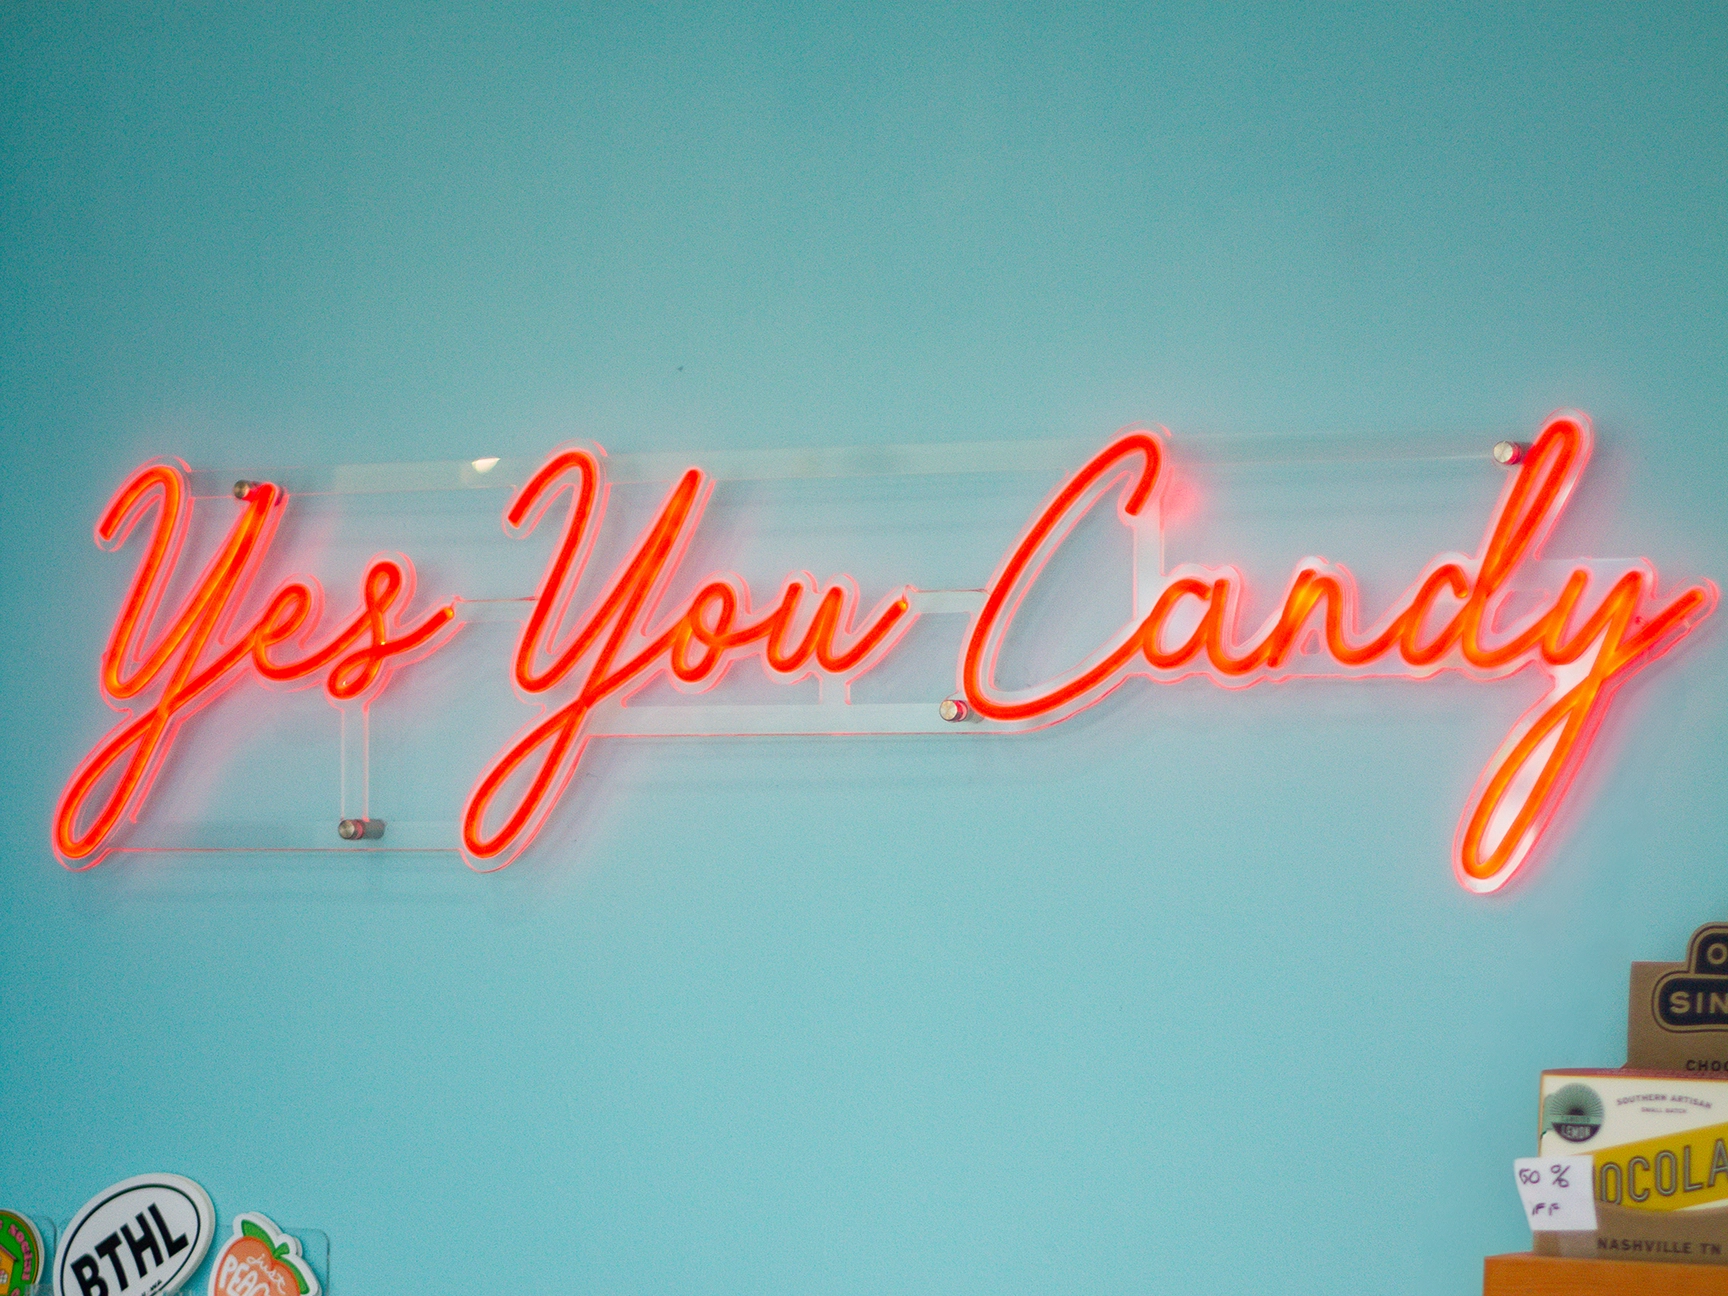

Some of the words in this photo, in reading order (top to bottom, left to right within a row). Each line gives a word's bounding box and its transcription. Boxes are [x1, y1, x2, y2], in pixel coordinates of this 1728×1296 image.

[54, 463, 457, 860] Yes
[462, 449, 909, 860] You
[963, 419, 1704, 880] Candy
[1686, 1059, 1728, 1072] CHO
[1597, 1238, 1692, 1254] NASHVILLE
[1700, 1242, 1721, 1255] TN
